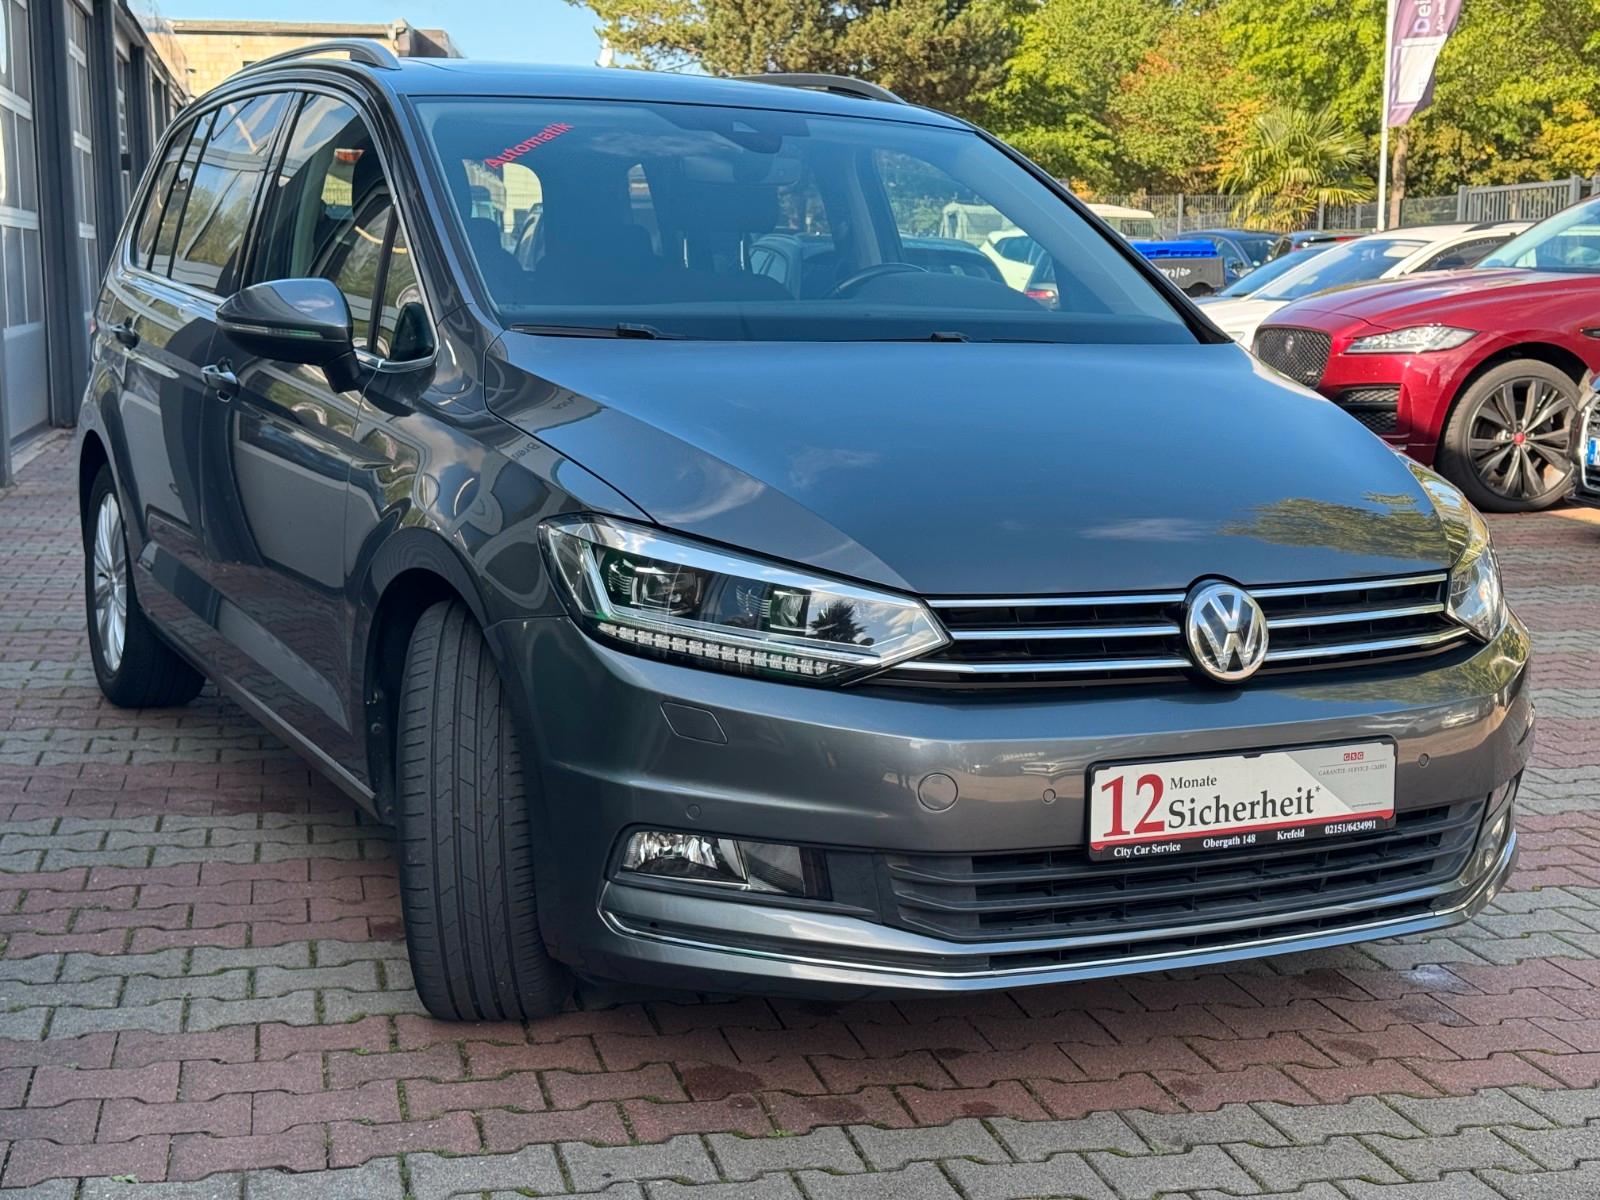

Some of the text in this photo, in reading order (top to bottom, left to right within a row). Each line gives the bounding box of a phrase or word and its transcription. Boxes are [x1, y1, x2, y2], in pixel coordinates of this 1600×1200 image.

[483, 122, 575, 169] Automatik
[1187, 583, 1268, 679] VW
[1100, 773, 1165, 838] 12
[1169, 775, 1218, 790] Monate
[1113, 820, 1377, 858] City Car Service Obergath 148 Krefeld 02151/6434991
